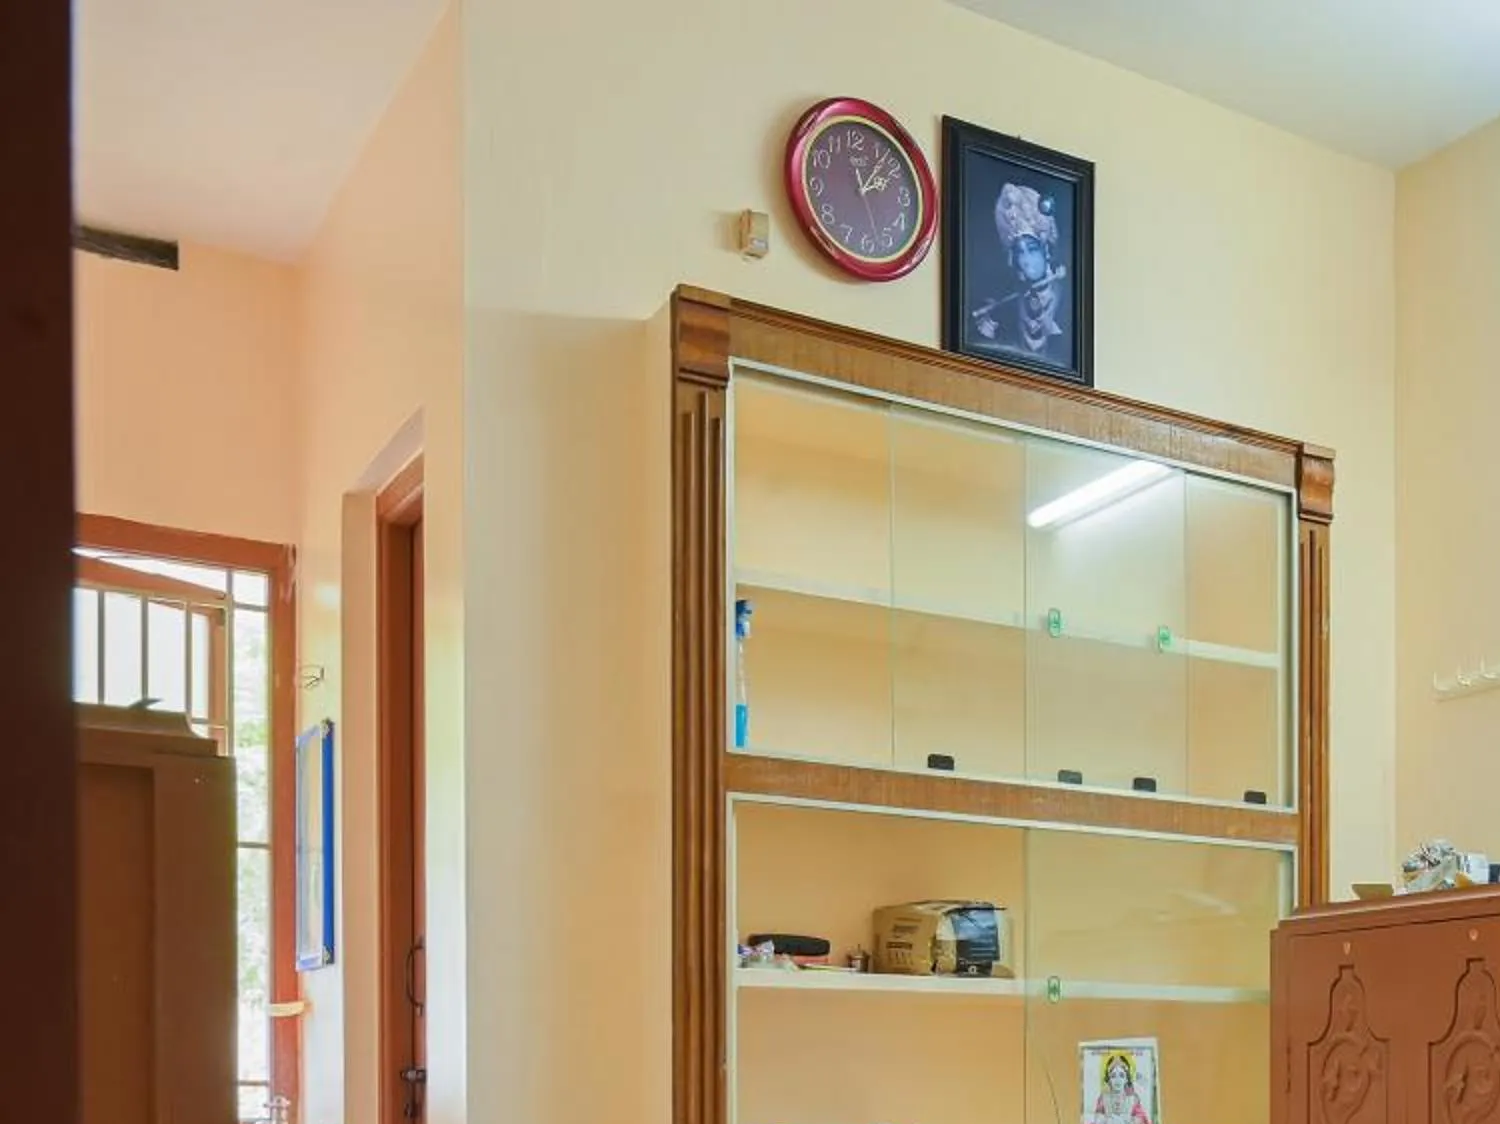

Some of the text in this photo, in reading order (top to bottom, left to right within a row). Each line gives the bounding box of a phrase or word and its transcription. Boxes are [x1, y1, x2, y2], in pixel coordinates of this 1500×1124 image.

[828, 135, 841, 153] 11
[848, 130, 865, 151] 12
[872, 142, 880, 158] 1
[813, 149, 831, 169] 10
[888, 157, 902, 178] 2
[810, 176, 824, 197] 9
[898, 186, 911, 207] 3
[821, 203, 836, 225] 8
[893, 213, 905, 231] 4
[840, 224, 853, 243] 7
[882, 227, 893, 248] 5
[861, 234, 875, 254] 6
